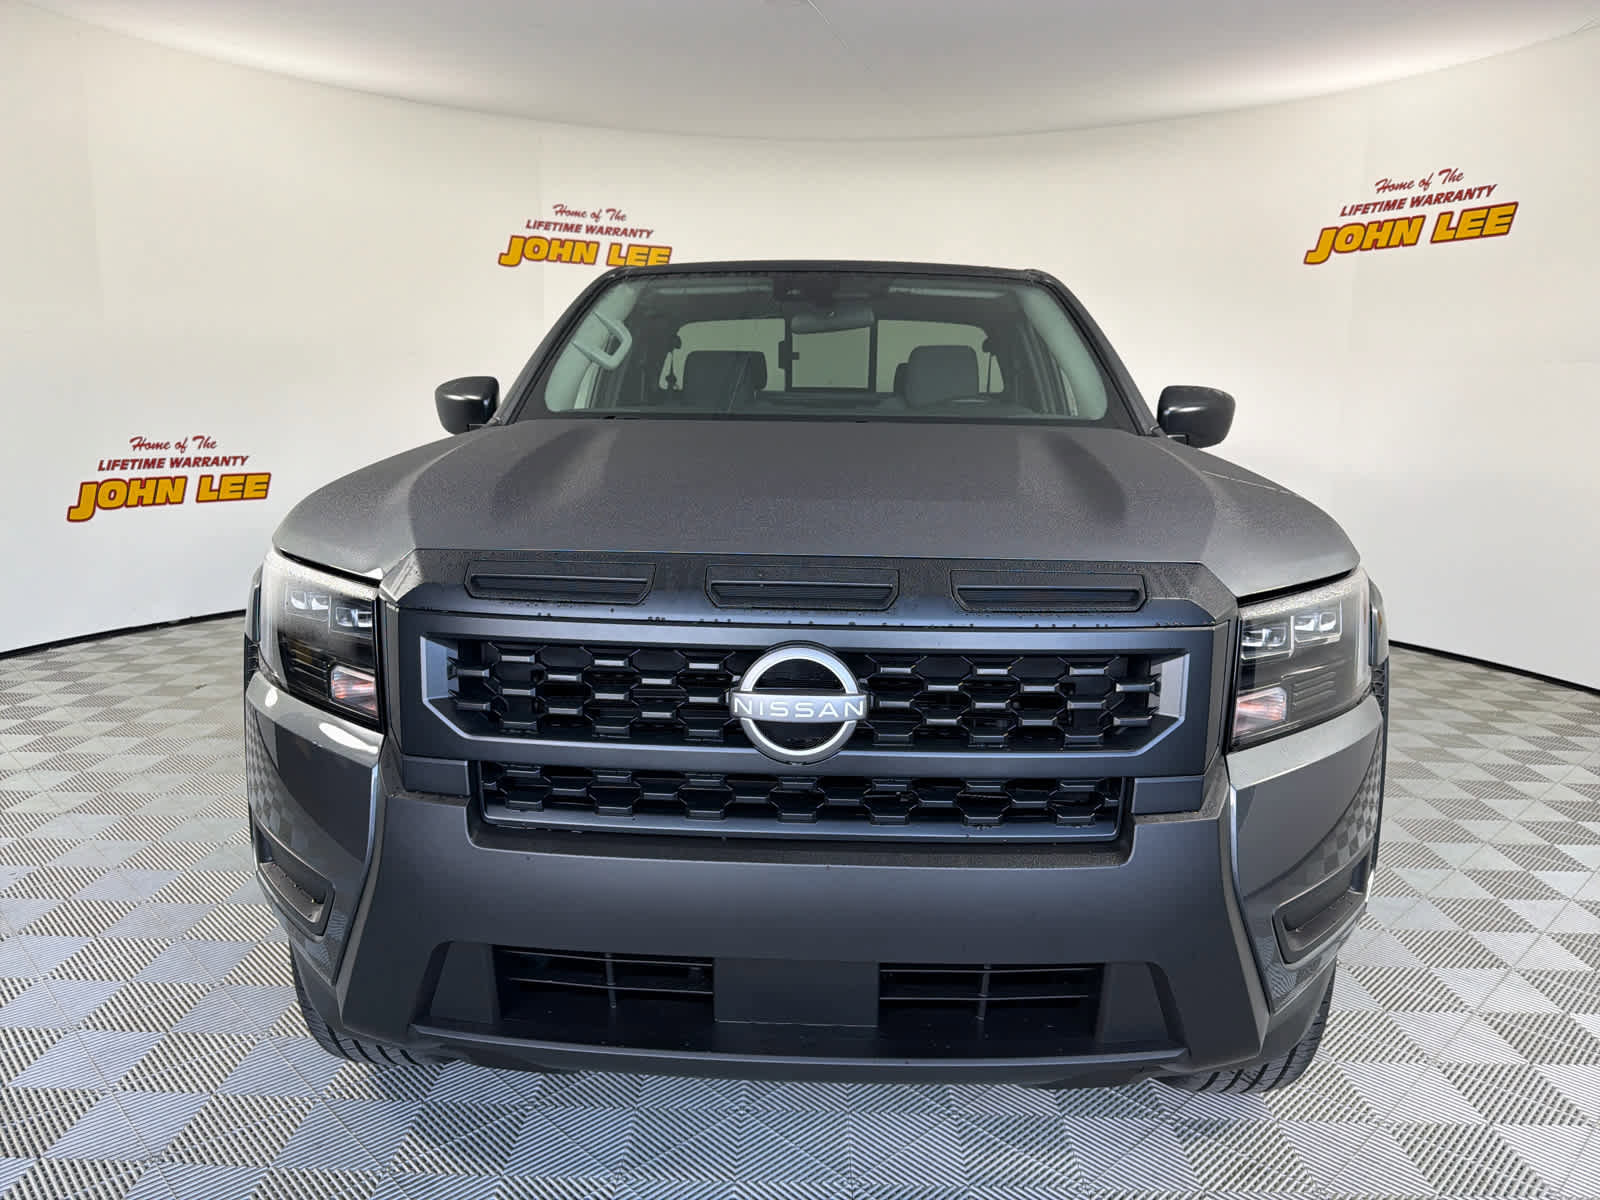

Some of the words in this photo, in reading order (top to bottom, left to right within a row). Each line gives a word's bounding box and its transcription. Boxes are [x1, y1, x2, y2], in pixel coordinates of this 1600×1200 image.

[1374, 178, 1415, 194] Home
[1418, 172, 1434, 192] of
[1437, 168, 1464, 185] The
[1338, 196, 1408, 217] LIFETIME
[1409, 183, 1498, 209] WARRANTY
[552, 203, 588, 219] Home
[590, 208, 603, 222] of
[605, 208, 627, 222] The
[525, 219, 582, 234] LIFETIME
[585, 224, 654, 239] WARRANTY
[1303, 215, 1426, 265] JOHN
[1430, 201, 1519, 244] LEE
[498, 234, 600, 267] JOHN
[606, 242, 672, 267] LEE
[128, 435, 171, 452] Home
[174, 437, 189, 454] of
[192, 435, 217, 450] The
[97, 457, 166, 472] LIFETIME
[169, 455, 249, 469] WARRANTY
[66, 475, 188, 523] JOHN
[195, 472, 271, 503] LEE
[733, 697, 864, 718] NISSAN
